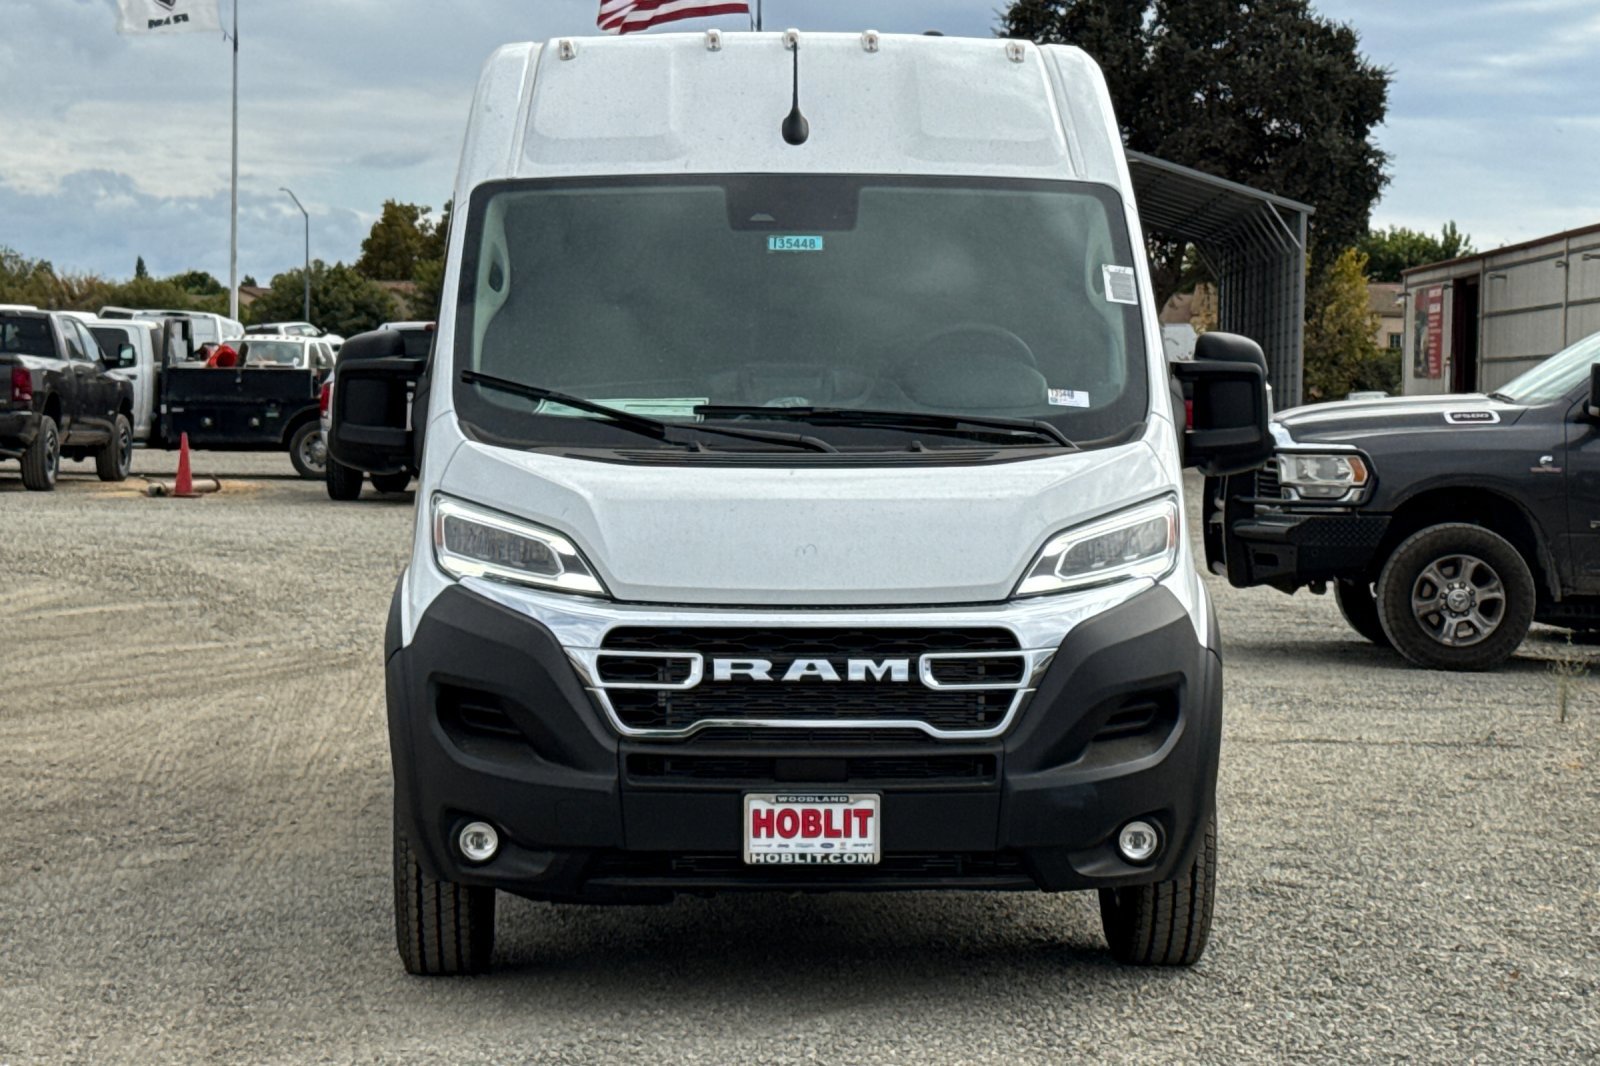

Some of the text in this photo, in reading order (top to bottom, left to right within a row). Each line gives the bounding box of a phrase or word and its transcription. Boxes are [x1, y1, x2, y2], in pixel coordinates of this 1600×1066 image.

[713, 658, 909, 682] RAM
[778, 795, 848, 803] WOODLAND
[752, 808, 874, 839] HOBLIT
[751, 852, 874, 864] HOBLIT.COM
